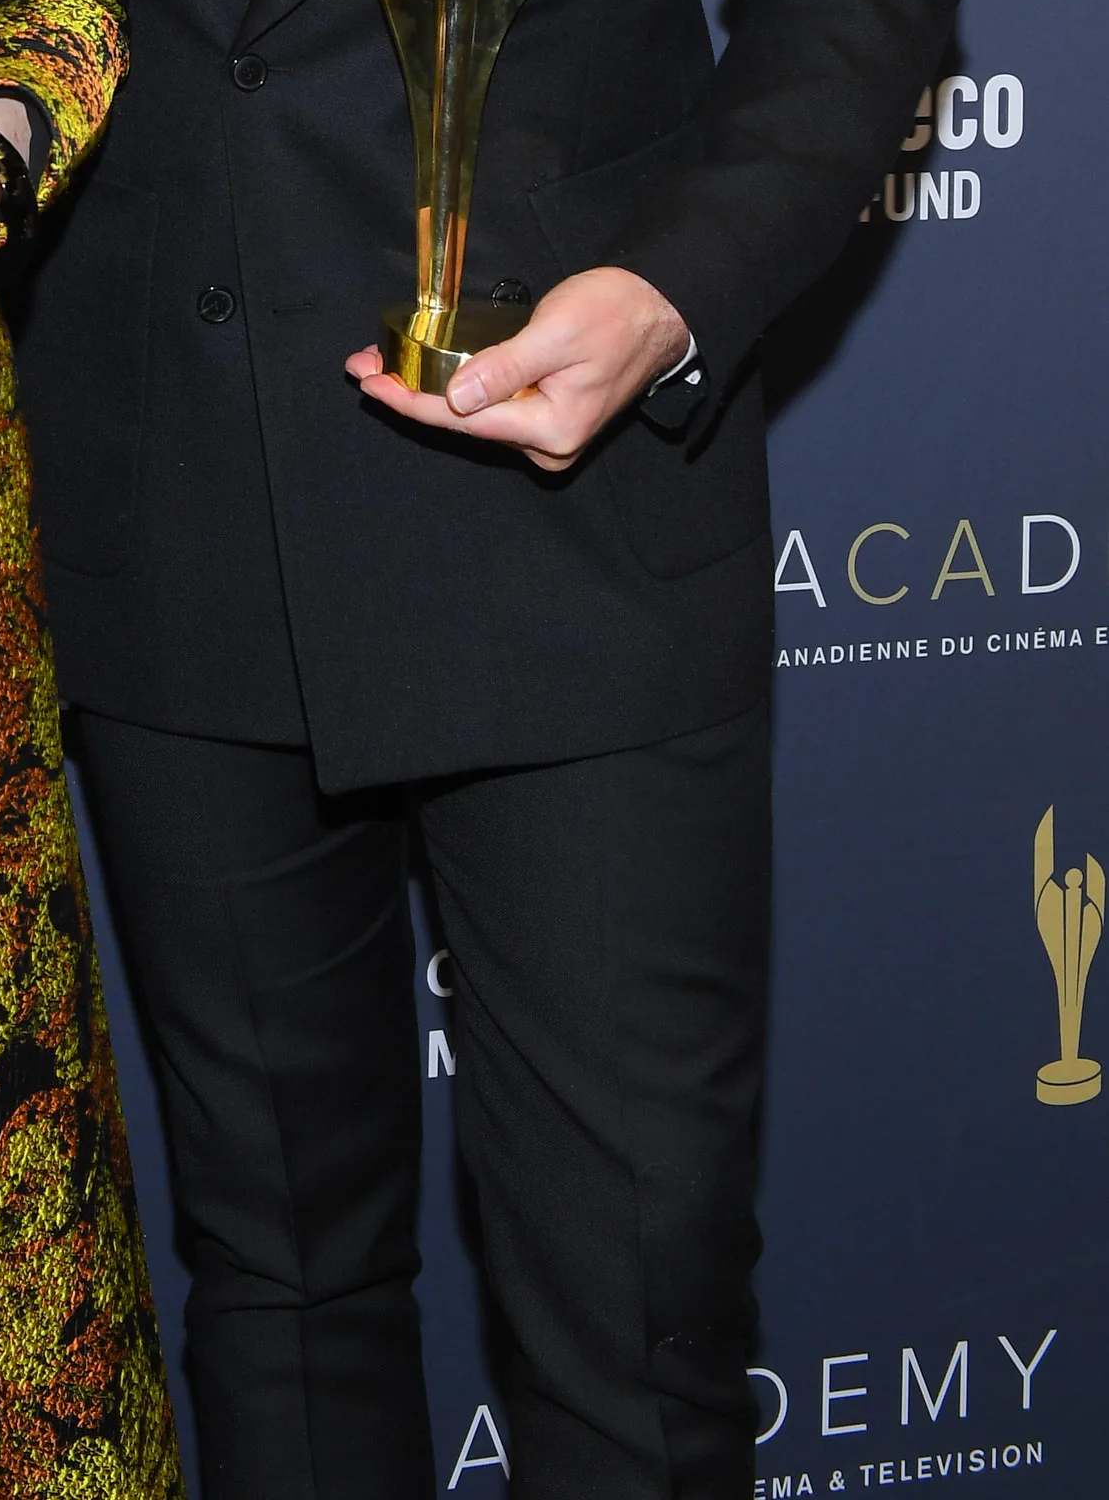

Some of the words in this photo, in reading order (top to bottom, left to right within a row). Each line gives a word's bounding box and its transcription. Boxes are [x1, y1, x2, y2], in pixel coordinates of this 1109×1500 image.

[858, 169, 981, 223] UND
[940, 635, 974, 656] DU
[986, 626, 1083, 653] CINÉMA
[829, 1469, 846, 1492] &
[859, 1441, 1043, 1487] TELEVISION
